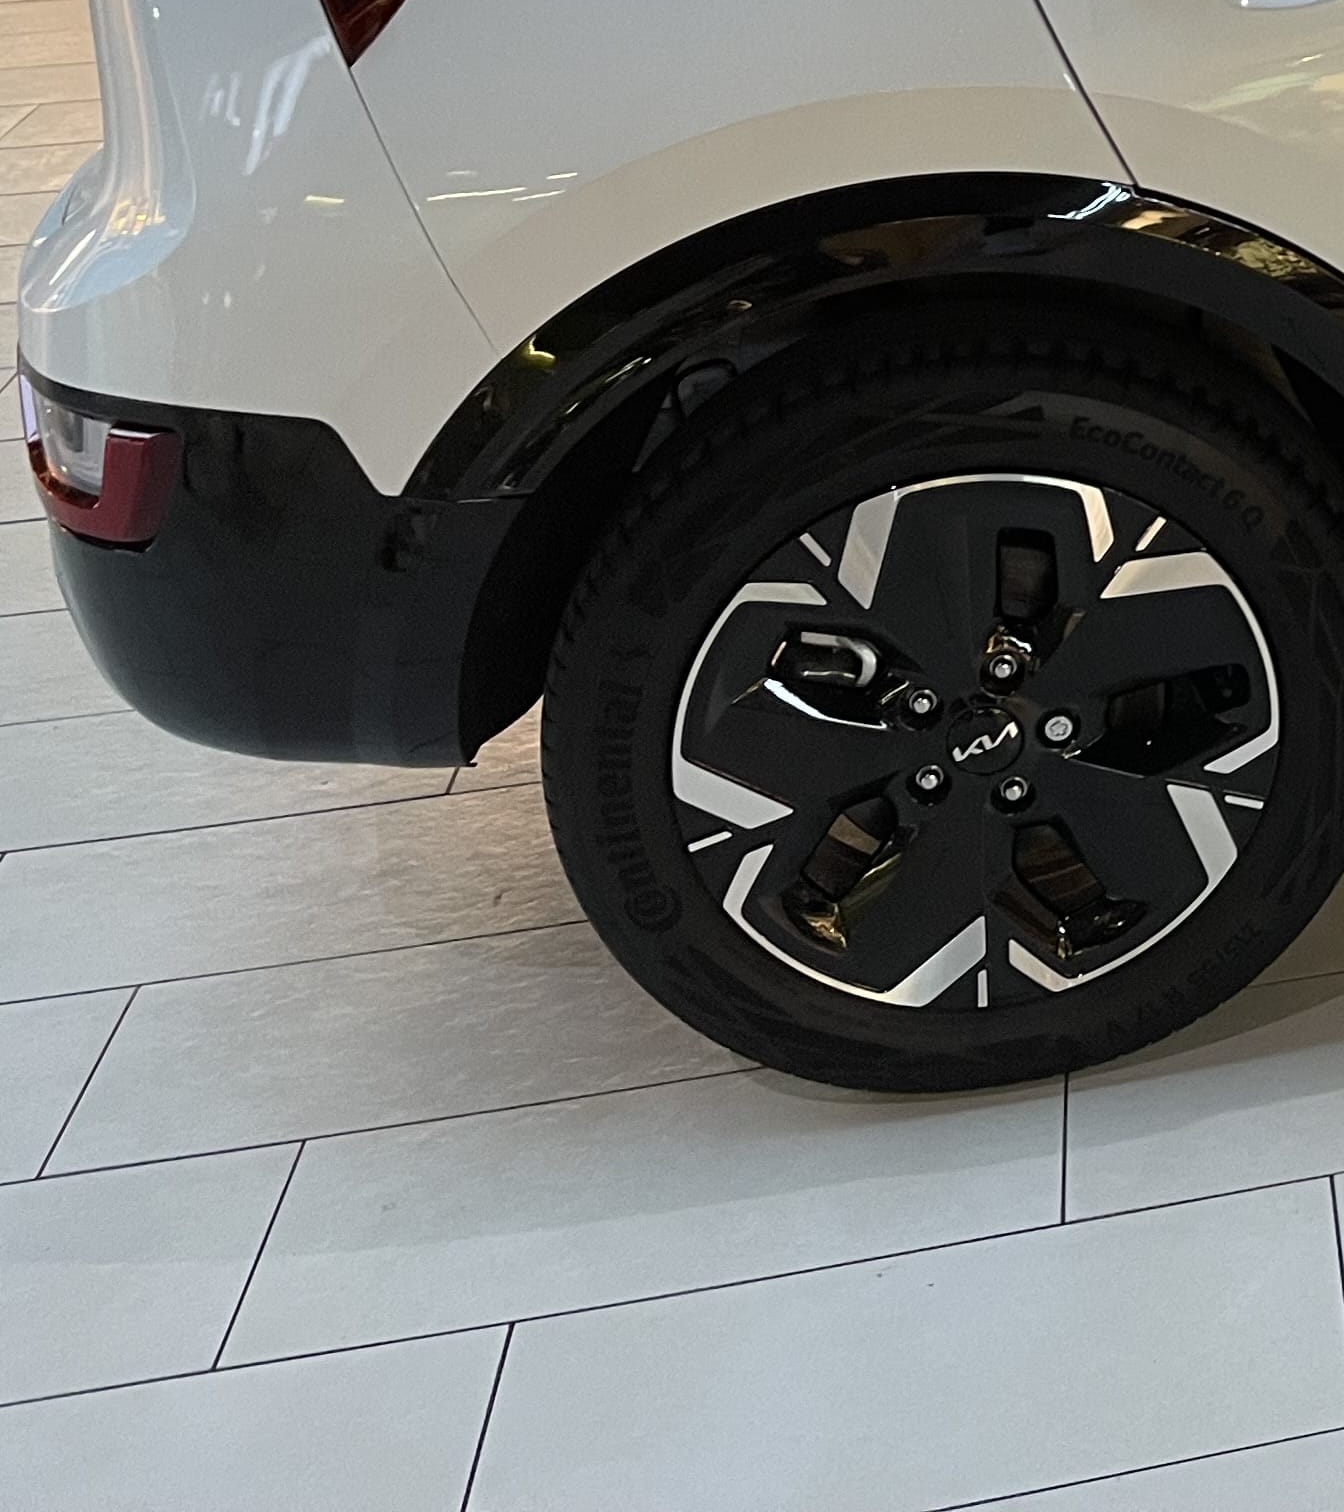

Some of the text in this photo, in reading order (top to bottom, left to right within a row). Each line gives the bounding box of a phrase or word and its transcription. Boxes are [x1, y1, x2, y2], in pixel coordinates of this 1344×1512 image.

[1068, 415, 1265, 535] EcoContact 6 Q
